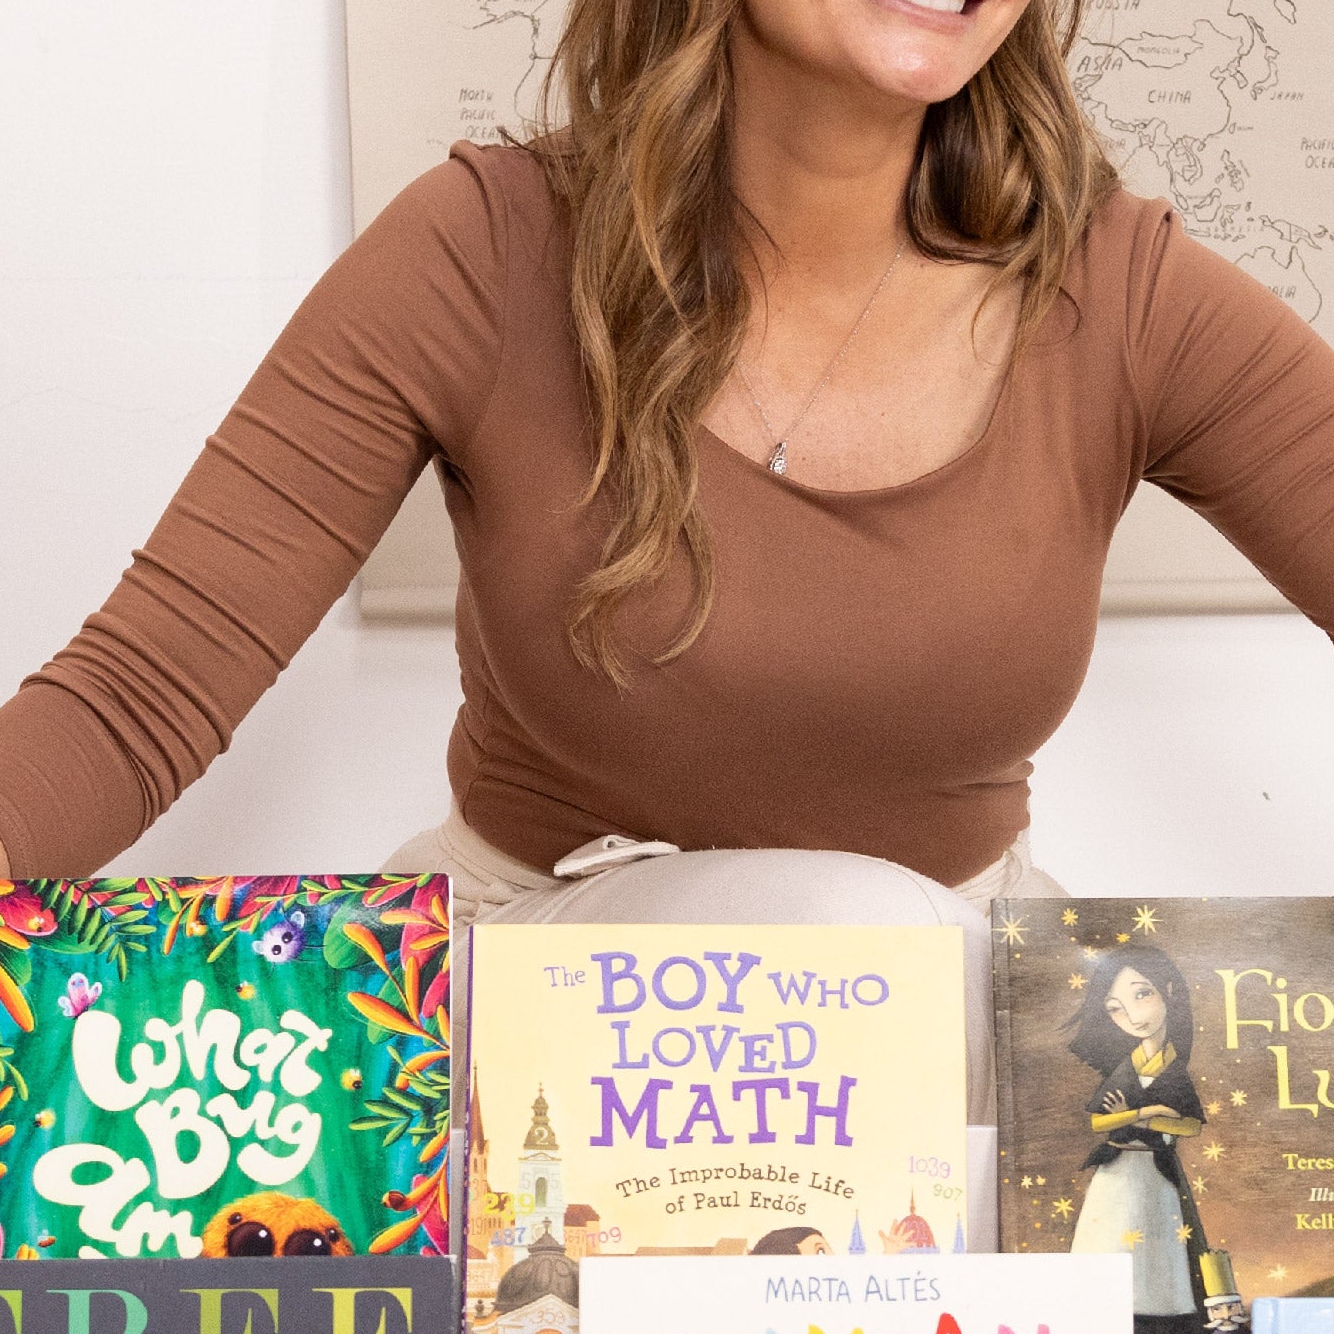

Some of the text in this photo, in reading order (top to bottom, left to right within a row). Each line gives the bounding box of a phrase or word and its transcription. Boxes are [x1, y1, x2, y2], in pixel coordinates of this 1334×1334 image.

[1077, 55, 1124, 73] ASIA
[1148, 89, 1192, 104] CHINA
[1269, 91, 1306, 102] JAPAN
[544, 951, 890, 1015] The BOY WHO
[72, 979, 333, 1111] What
[610, 1020, 818, 1074] LOVED
[589, 1074, 858, 1150] MATH
[134, 1088, 322, 1199] Bug
[534, 1127, 549, 1145] 2
[908, 1155, 951, 1180] 1039
[615, 1163, 855, 1200] The Improbable Life
[933, 1182, 963, 1201] 907
[665, 1190, 808, 1216] of Paul Erdős
[490, 1226, 526, 1247] 487
[765, 1269, 942, 1304] MARTA ALTÉS
